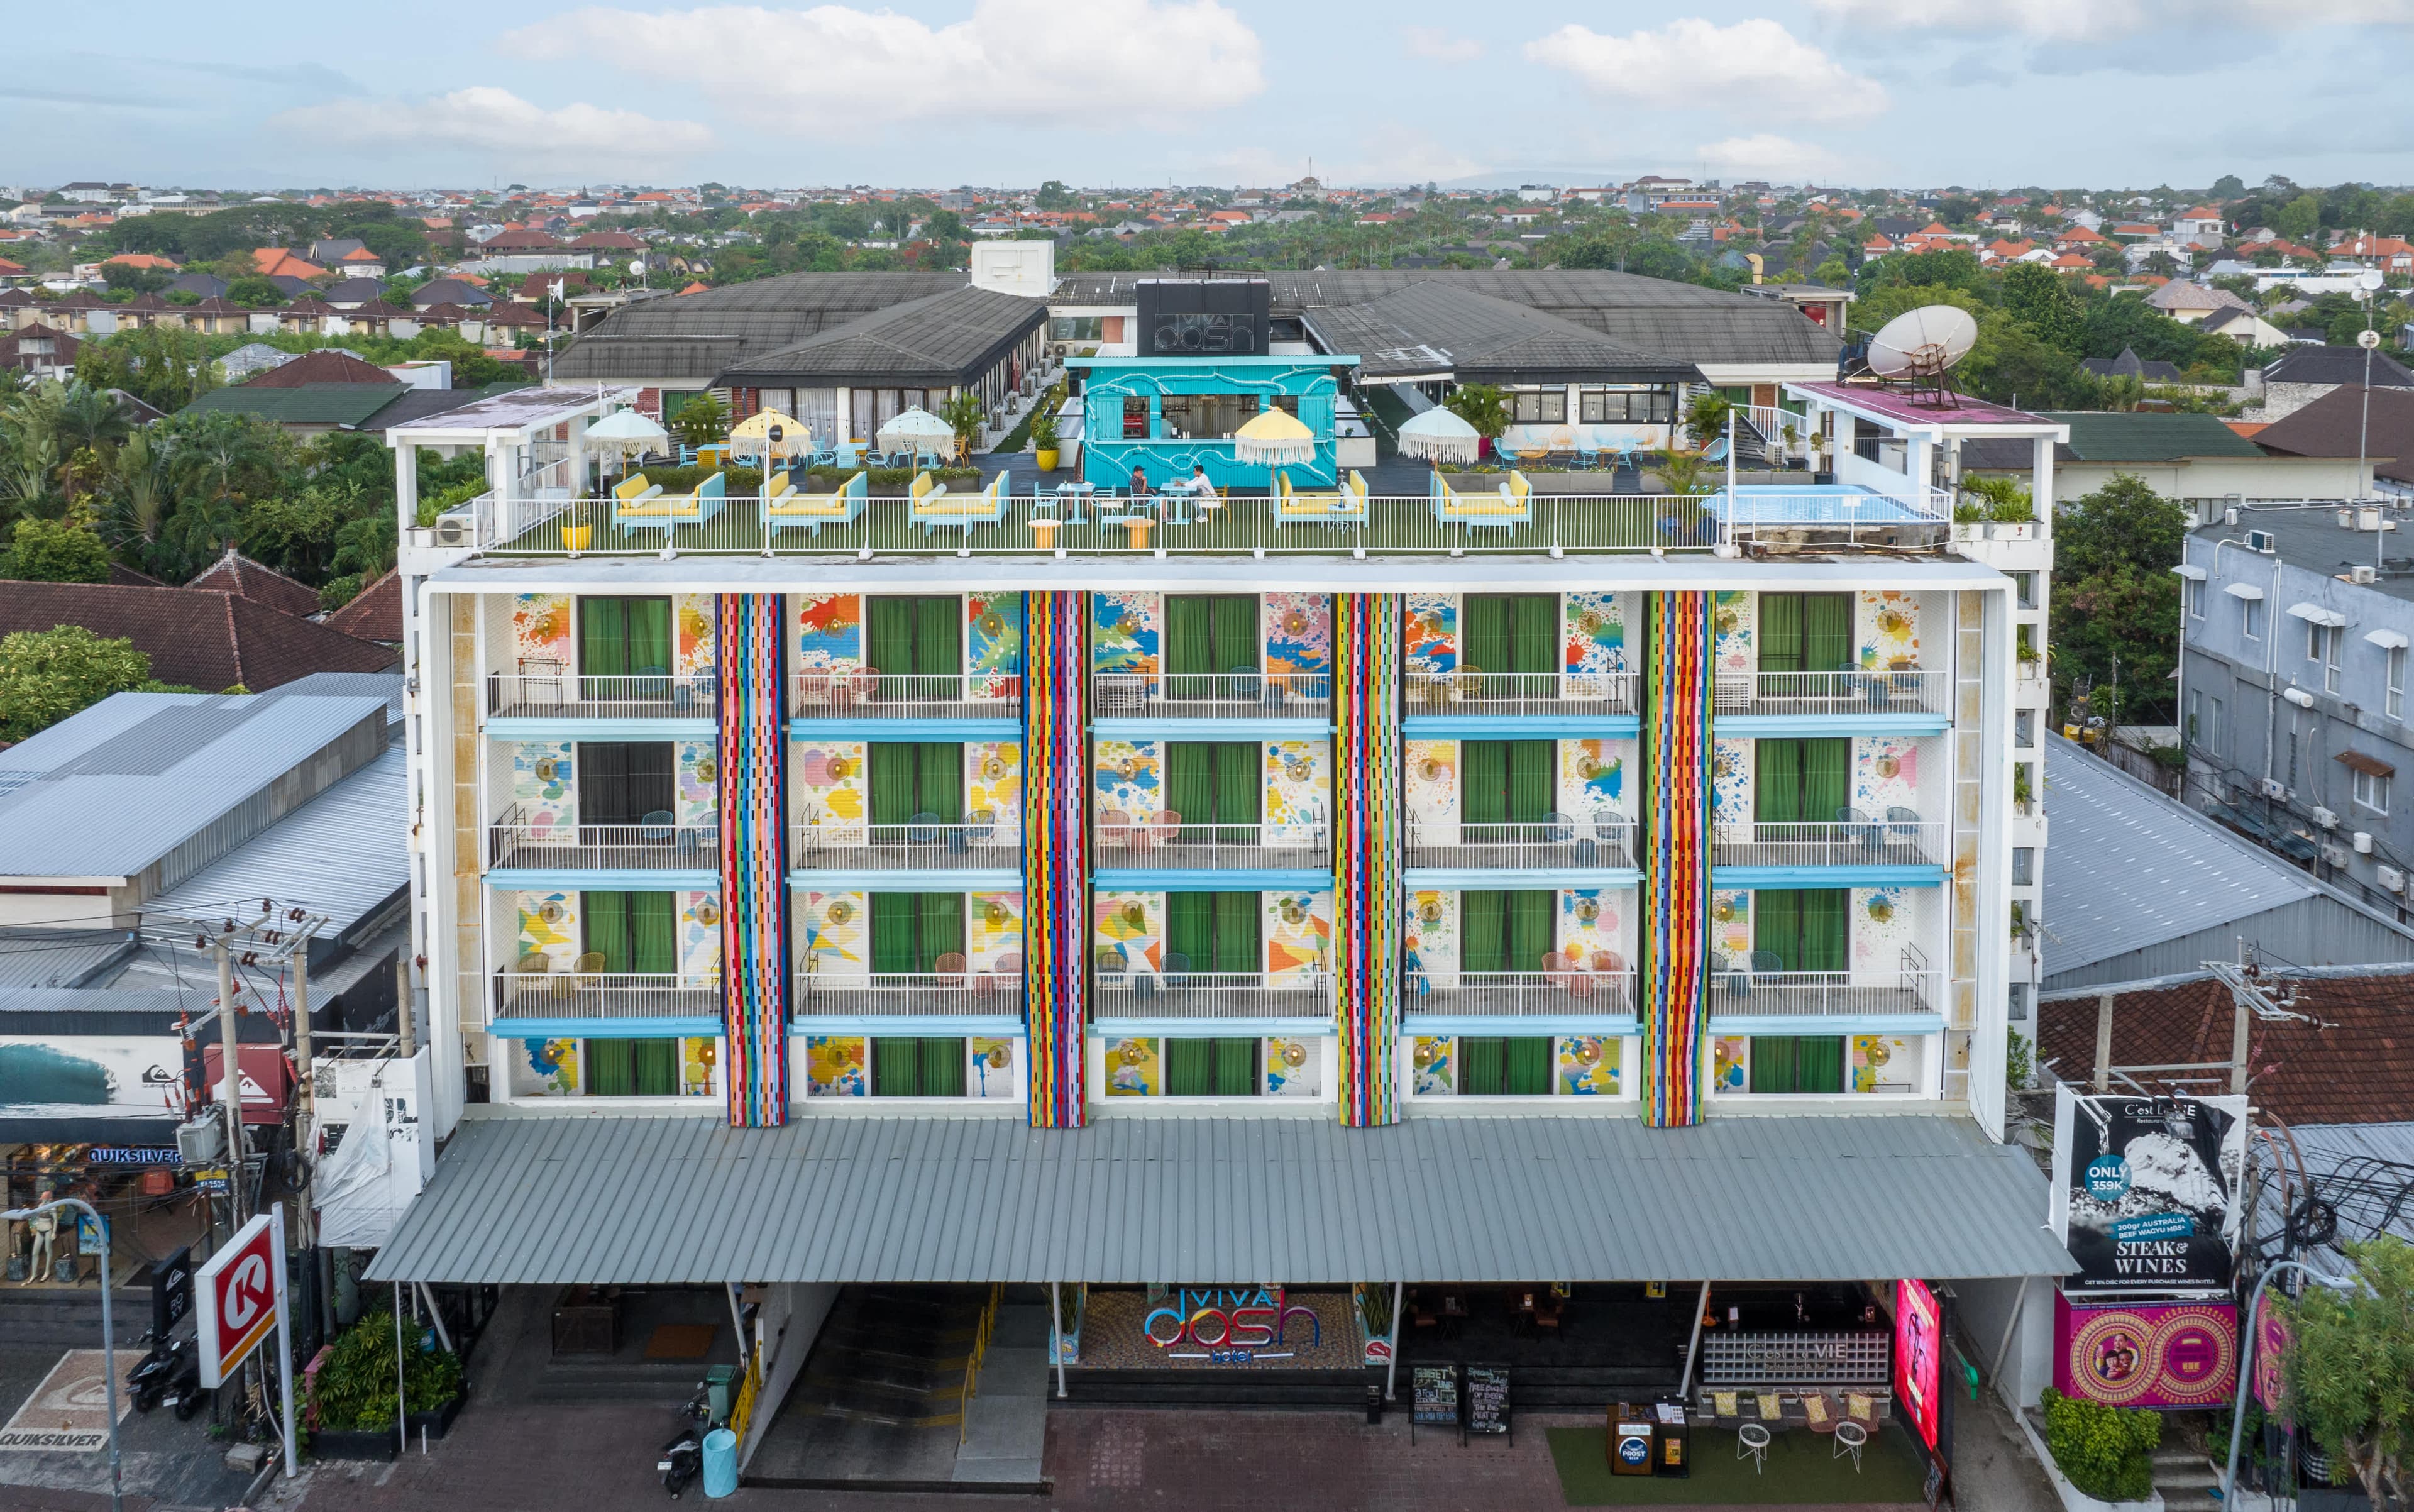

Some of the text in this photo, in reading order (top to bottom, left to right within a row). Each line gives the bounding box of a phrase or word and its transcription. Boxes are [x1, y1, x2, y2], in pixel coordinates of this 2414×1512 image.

[1182, 315, 1227, 326] VIVA
[1155, 314, 1254, 350] dash
[2125, 1104, 2153, 1115] C'est
[88, 1149, 184, 1164] QUIKSILVER
[2088, 1167, 2127, 1178] ONLY
[2092, 1180, 2124, 1191] 359K
[2142, 1217, 2186, 1227] AUSTRALIA
[2118, 1230, 2137, 1239] BEEF
[2138, 1227, 2166, 1236] WAGYU
[2117, 1241, 2176, 1256] STEAK
[2115, 1259, 2187, 1274] WINES
[1191, 1289, 1274, 1306] VIVA
[1144, 1288, 1320, 1348] dash
[1212, 1350, 1252, 1363] hotel
[1747, 1344, 1786, 1359] C'est
[1814, 1344, 1847, 1359] VIE
[0, 1433, 102, 1446] QUIKSILVER
